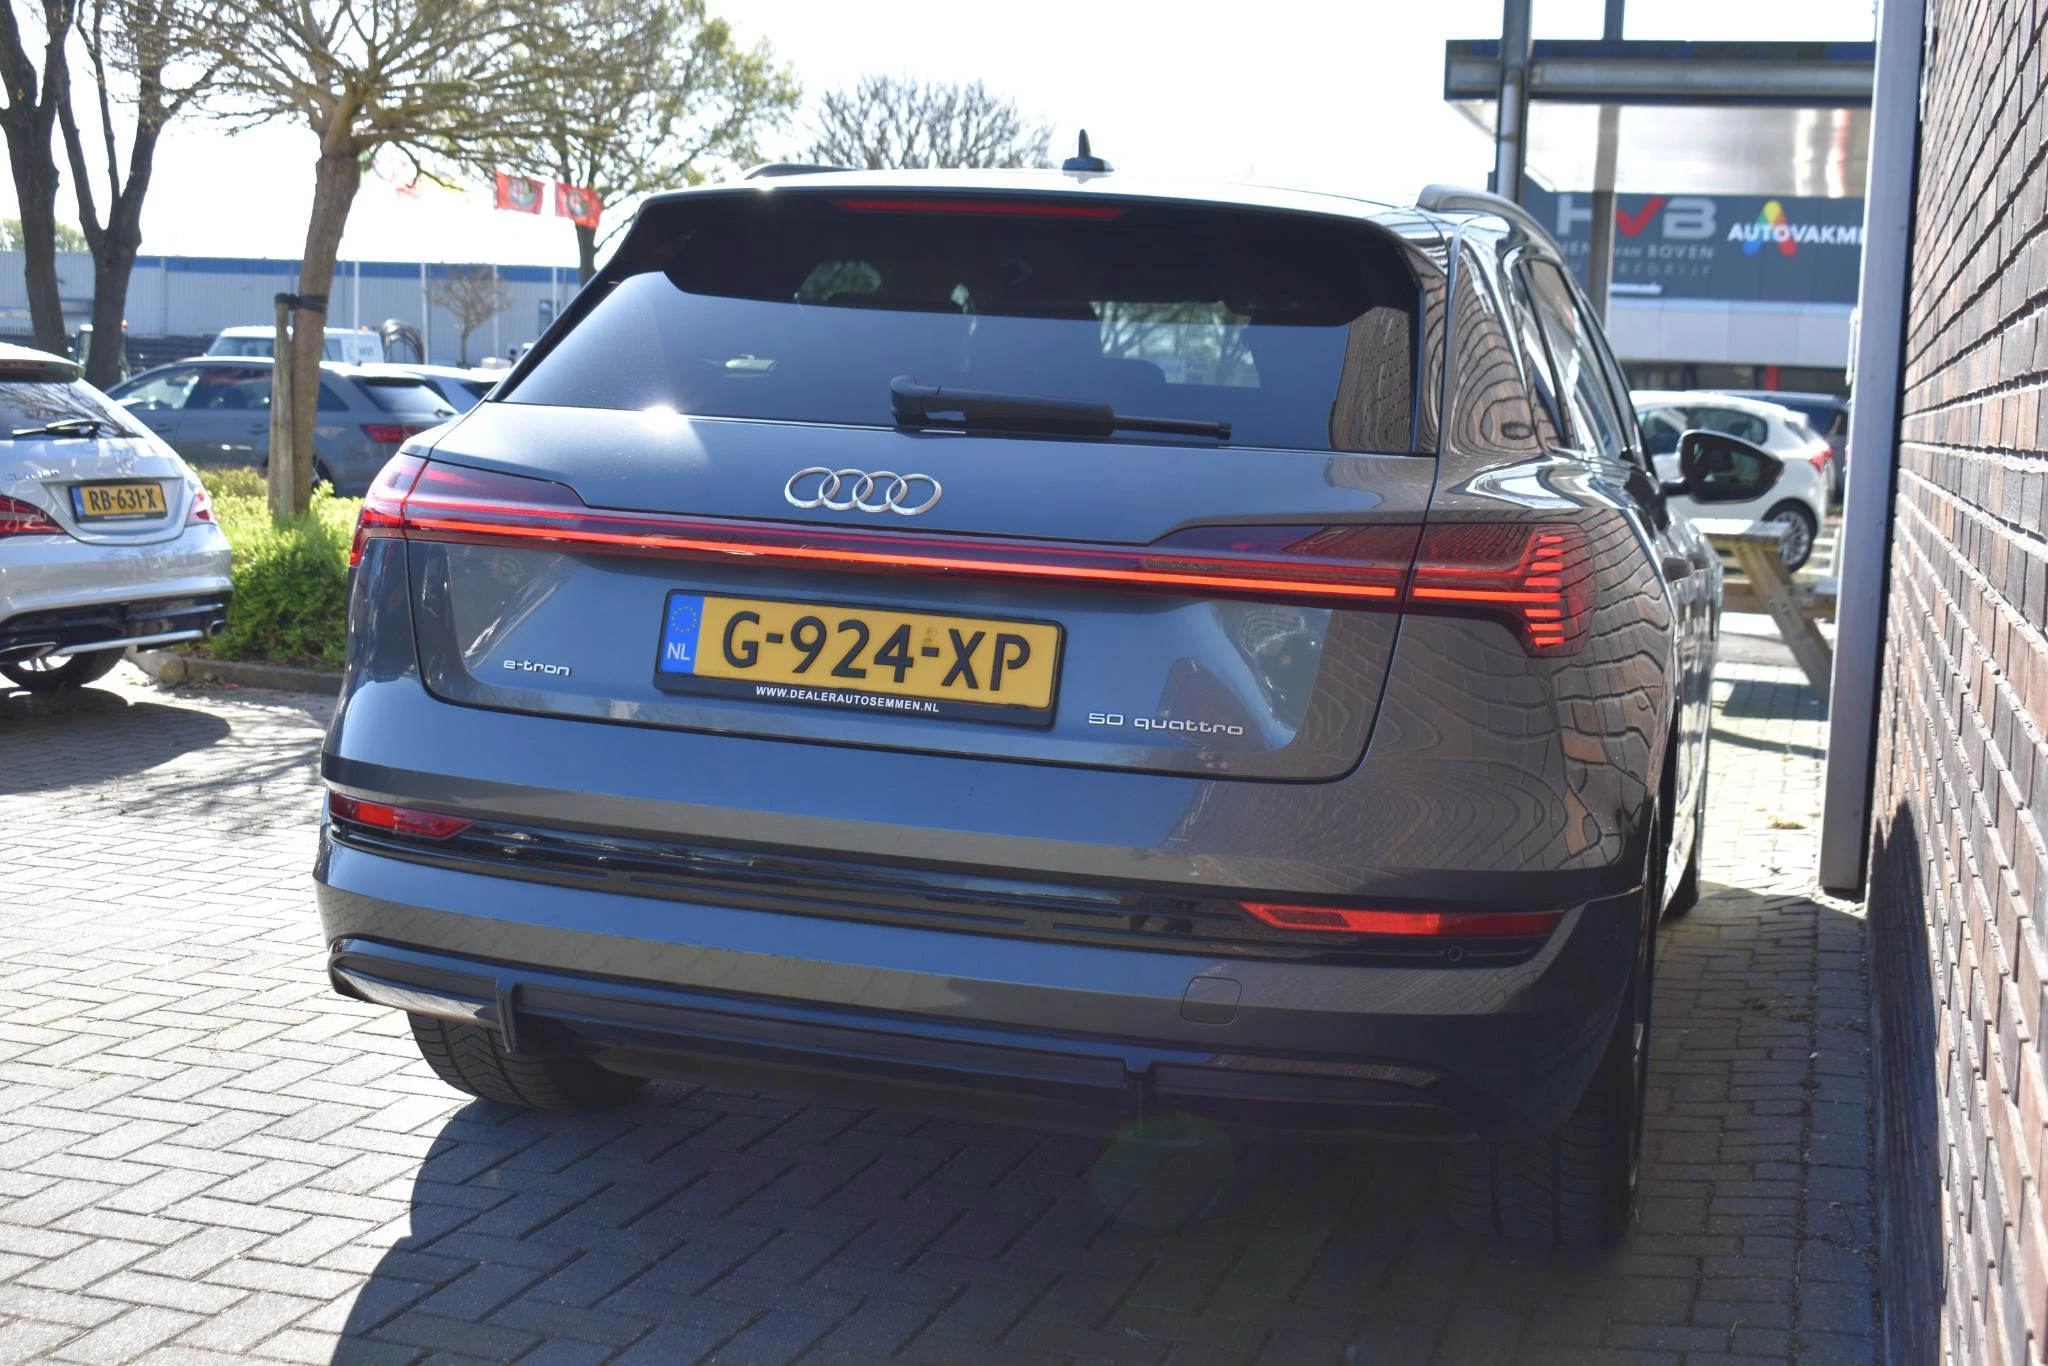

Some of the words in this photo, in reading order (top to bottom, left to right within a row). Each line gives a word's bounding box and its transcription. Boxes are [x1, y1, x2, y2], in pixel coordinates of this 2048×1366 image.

[1555, 194, 1717, 239] HVB
[88, 488, 157, 511] RB-631-X
[667, 642, 690, 661] NL
[722, 611, 1031, 691] G-924-XP
[503, 659, 570, 676] e-tron
[756, 686, 940, 713] WWW.DEALERAUTOSEMMEN.NL
[1088, 712, 1124, 726] 50
[1134, 718, 1243, 736] quattro
